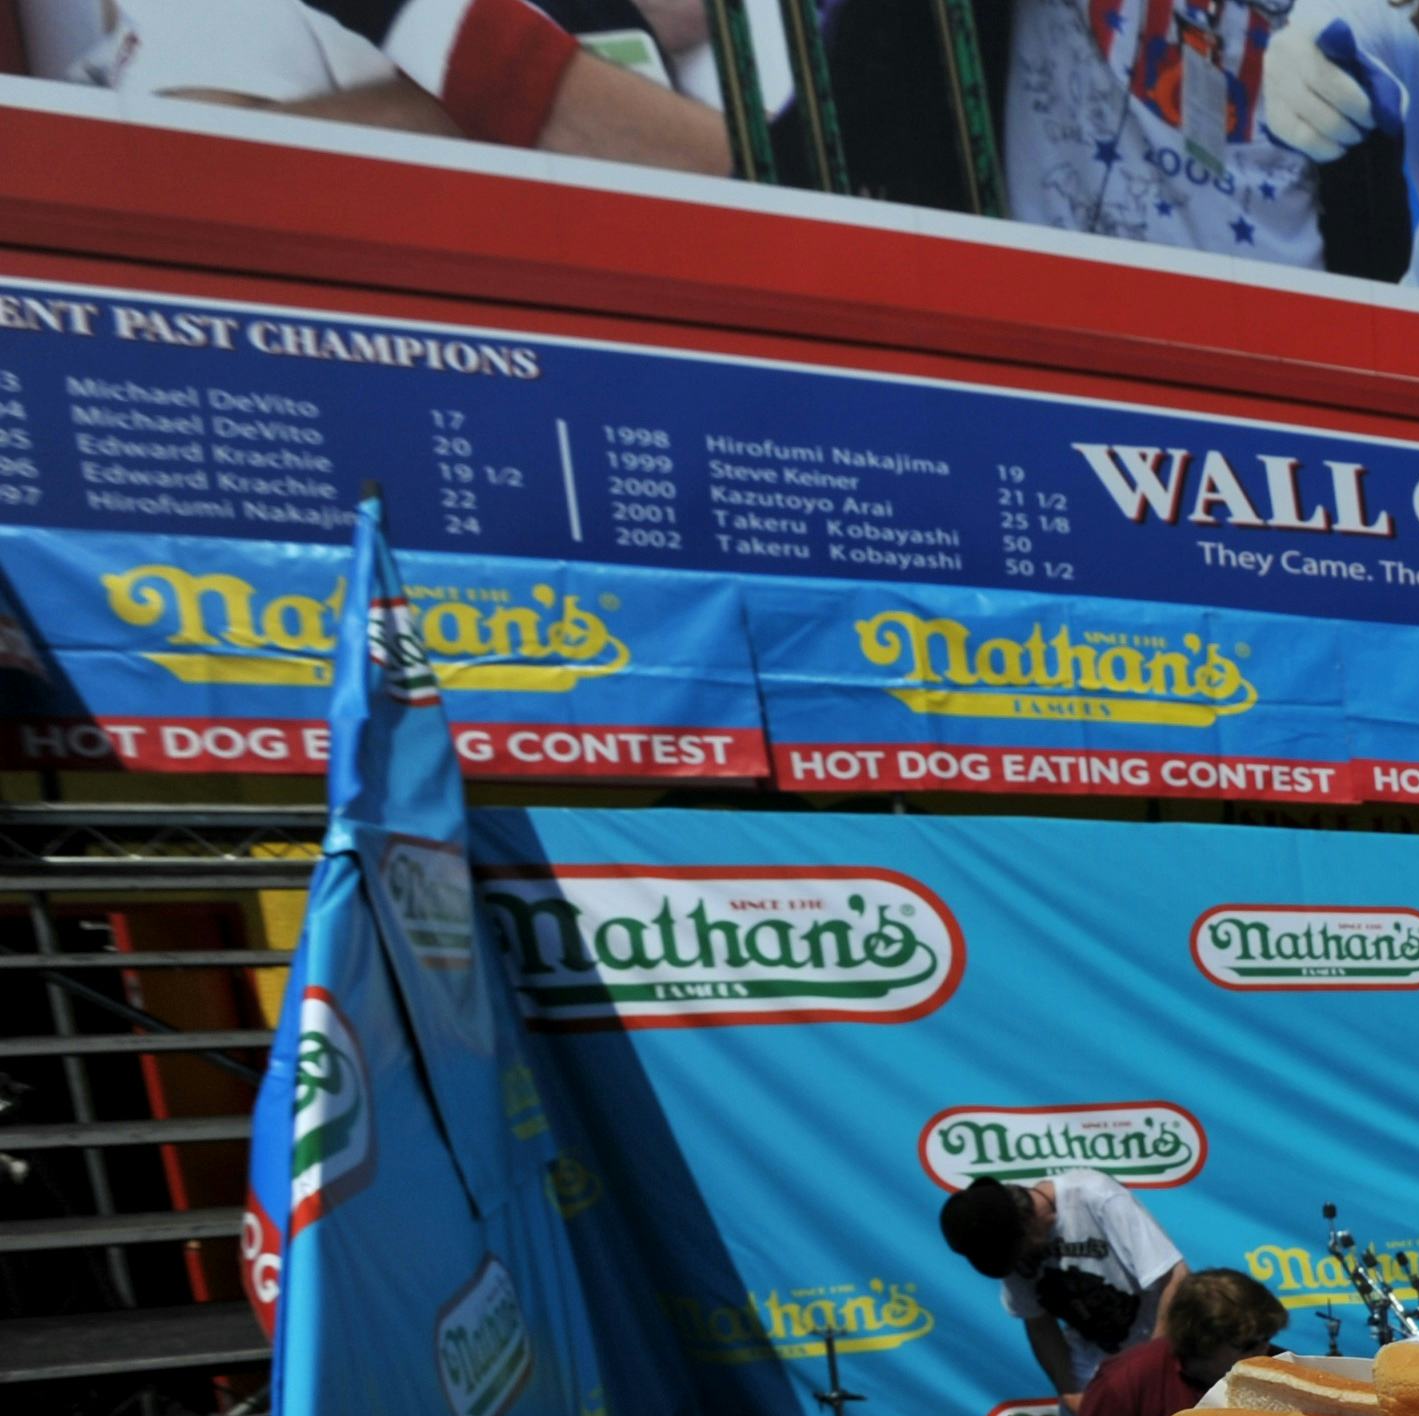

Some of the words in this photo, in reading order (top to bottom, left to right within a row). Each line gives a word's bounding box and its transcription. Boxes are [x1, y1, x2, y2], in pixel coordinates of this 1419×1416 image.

[110, 305, 239, 350] PAST
[247, 319, 543, 380] CHAMPIONS
[66, 374, 200, 409] Michael
[206, 386, 320, 419] DeVito
[70, 403, 205, 436] Michael
[212, 415, 325, 446] DeVito
[430, 408, 465, 430] 17
[75, 432, 205, 464] Edward
[432, 434, 472, 458] 20
[604, 425, 671, 450] 1998
[706, 433, 825, 463] Hirofumi
[832, 446, 951, 476] Nakajima
[997, 463, 1026, 484] 19
[81, 460, 210, 492] Edward
[437, 461, 475, 484] 19
[606, 450, 674, 474] 1999
[709, 459, 778, 485] Steve
[783, 465, 860, 491] Keiner
[998, 487, 1025, 507] 21
[1070, 441, 1395, 538] WALL
[86, 488, 236, 519] Hirofumi
[243, 500, 361, 530] Nakajim
[441, 487, 478, 511] 22
[609, 475, 677, 500] 2000
[710, 485, 835, 516] Kazutoyo
[842, 497, 894, 519] Arai
[1001, 511, 1030, 531] 25
[445, 513, 482, 536] 24
[612, 501, 677, 524] 2001
[713, 509, 808, 536] Takeru
[827, 518, 960, 548] Kobayashi
[1003, 535, 1033, 554] 50
[616, 526, 684, 551] 2002
[716, 533, 811, 560] Takeru
[829, 543, 963, 572] Kobayashi
[1006, 558, 1035, 578] 50
[1196, 540, 1275, 577] They
[1281, 549, 1374, 584] Came.
[101, 565, 630, 662] Naan's
[854, 610, 1258, 700] Nathan's
[24, 723, 142, 760] HOT
[162, 725, 290, 761] DOG
[506, 729, 733, 767] CONTEST
[789, 751, 886, 781] HOT
[897, 752, 993, 782] DOG
[1001, 754, 1152, 786] EATING
[1161, 759, 1336, 794] CONTEST
[497, 890, 937, 973] Nathan's
[939, 1116, 1192, 1164] Nathan's
